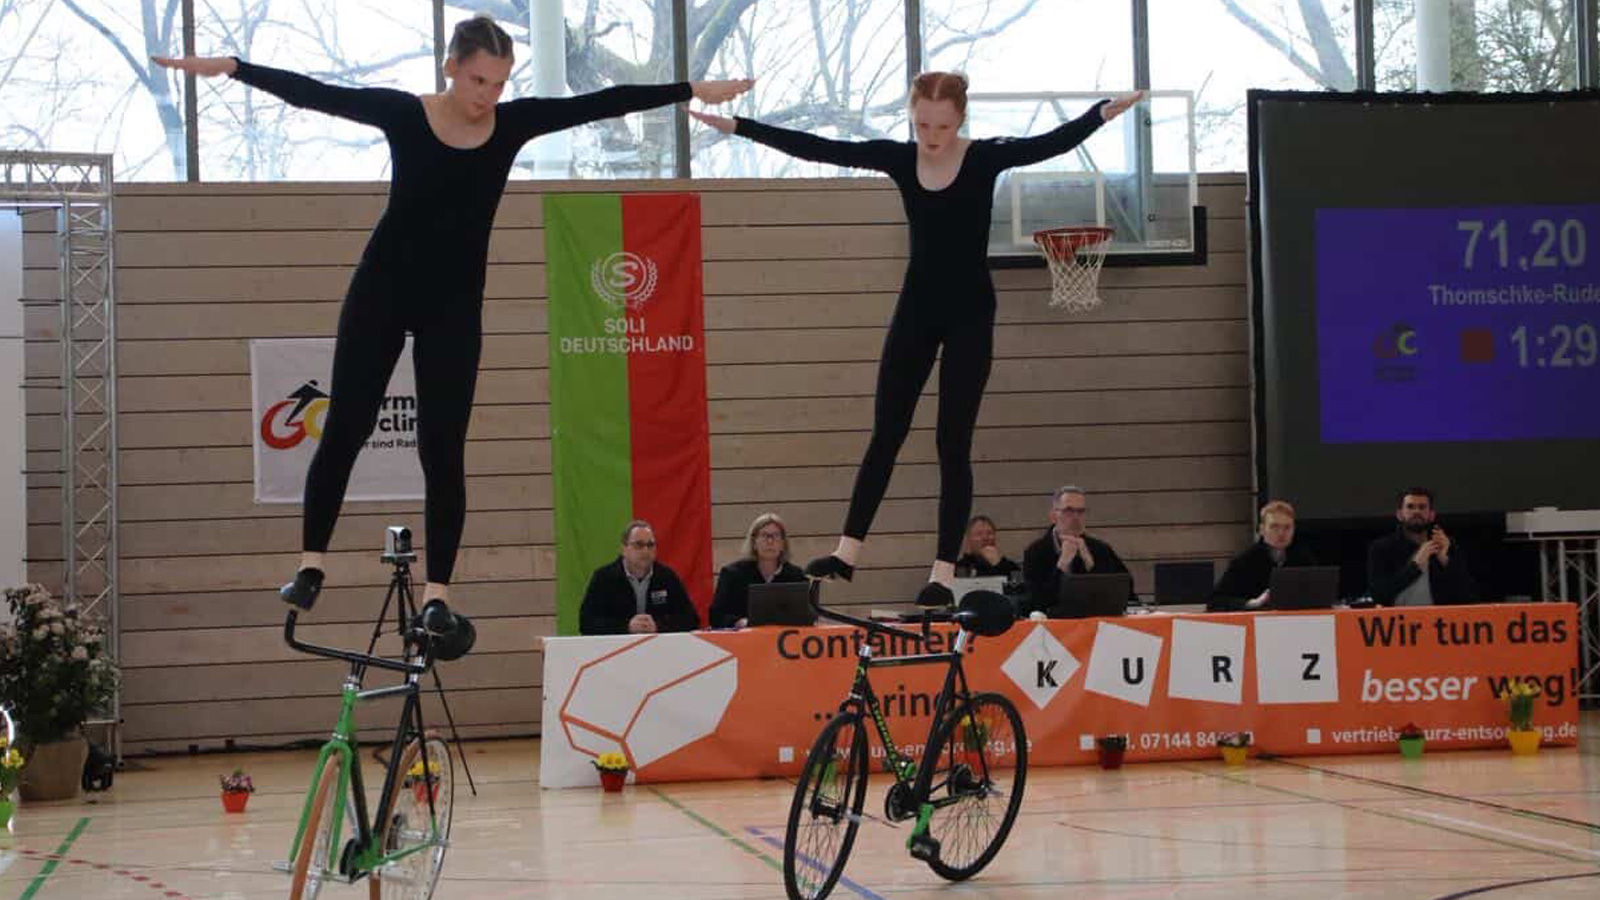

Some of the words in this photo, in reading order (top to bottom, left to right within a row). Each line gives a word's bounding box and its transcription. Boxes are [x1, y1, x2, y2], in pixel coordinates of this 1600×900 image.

[604, 317, 646, 334] SOLI
[560, 334, 694, 354] DEUTSCHLAND
[1511, 323, 1598, 368] 1:29
[1358, 613, 1422, 647] Wir
[1434, 616, 1494, 646] tun
[1507, 611, 1567, 644] das
[1362, 669, 1479, 703] besser
[1140, 731, 1192, 750] 07144
